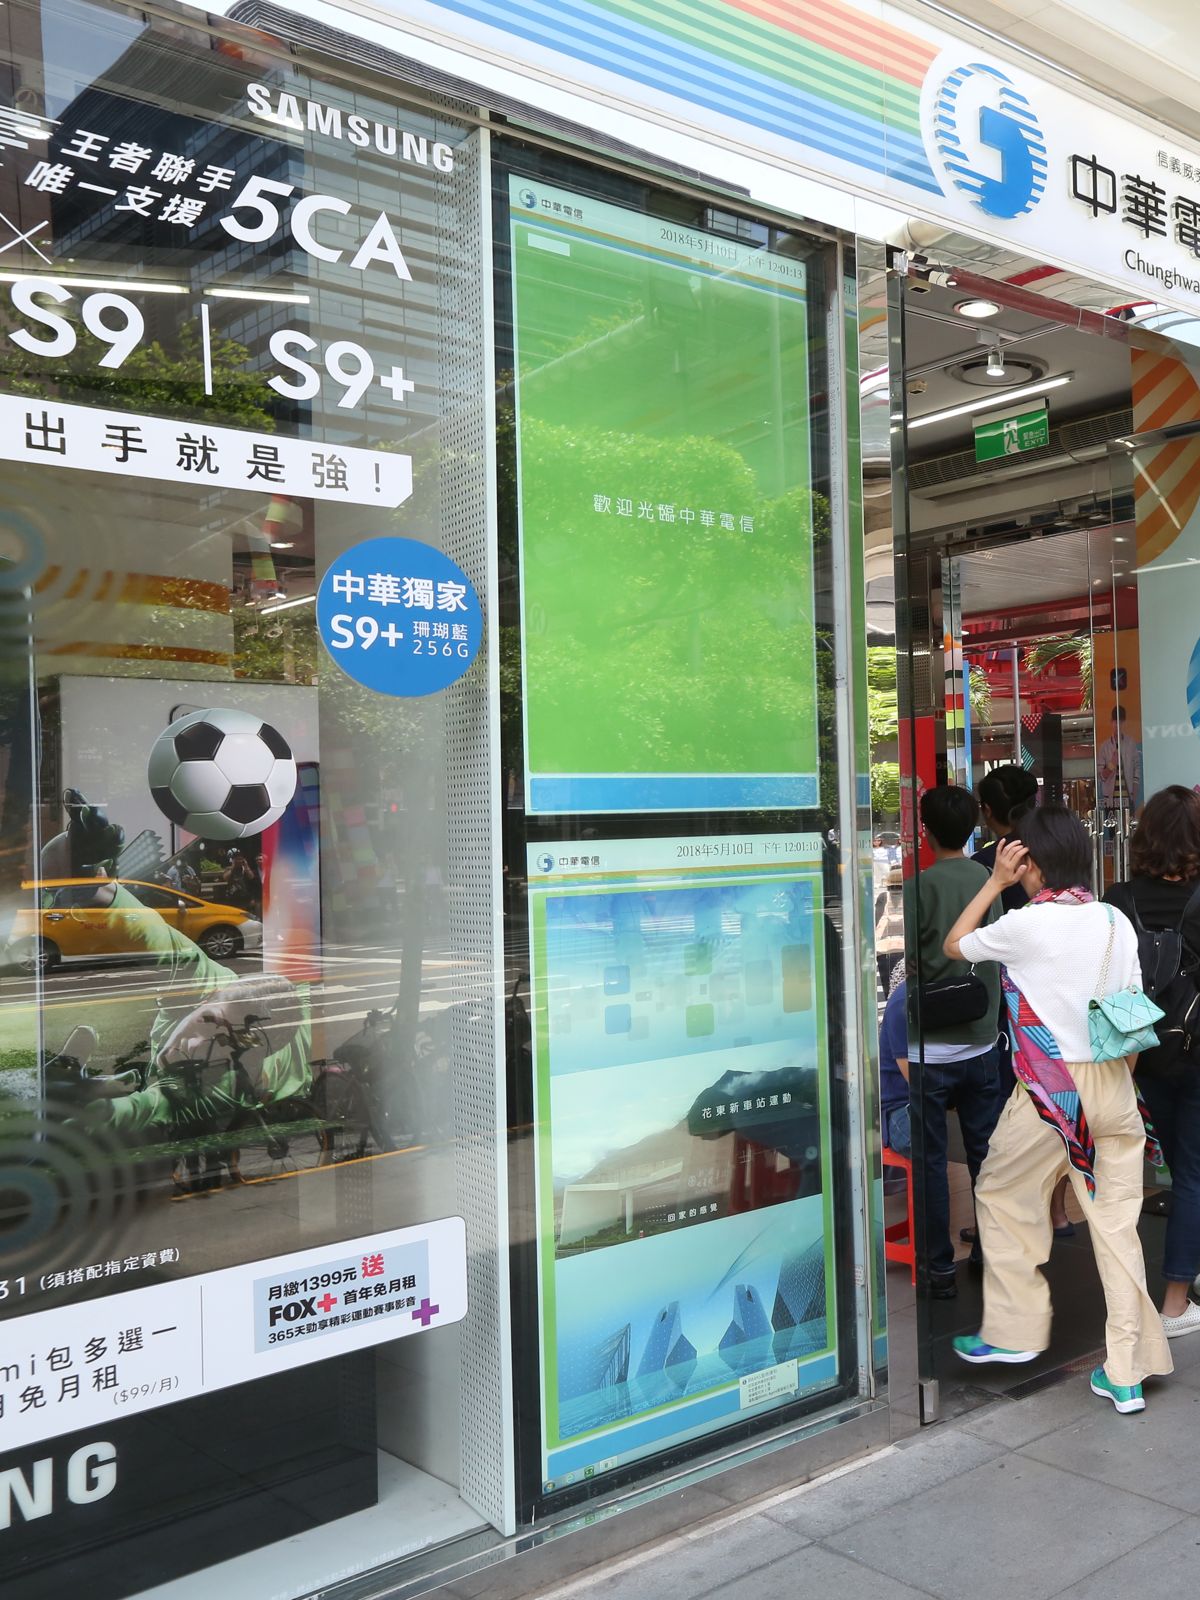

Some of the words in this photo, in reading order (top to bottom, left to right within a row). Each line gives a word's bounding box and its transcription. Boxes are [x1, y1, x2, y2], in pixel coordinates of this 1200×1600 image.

[246, 83, 454, 173] SAMSUNG
[60, 129, 236, 193] 王者聯手
[24, 161, 206, 228] 唯一支援
[541, 199, 583, 220] 中華電信
[219, 176, 413, 282] 5CA
[1124, 248, 1200, 295] Chunghwa
[8, 278, 145, 369] S9
[267, 329, 415, 409] S9+
[1025, 437, 1045, 446] EXIT
[593, 493, 755, 534] 歡迎光臨中華電信
[332, 570, 468, 612] 中華獨家
[331, 614, 403, 650] S9+
[413, 621, 468, 640] 珊瑚藍
[413, 640, 468, 658] 256G
[558, 855, 600, 867] 中華電信
[676, 842, 753, 858] 2018年5月10日
[784, 840, 819, 853] 12:01:10
[702, 1092, 792, 1119] 花東新車站運動
[667, 1203, 718, 1223] 回家的感覺
[40, 1248, 180, 1290] (須搭配指定資費)
[268, 1267, 357, 1300] 月繳1399元
[362, 1254, 385, 1279] 送
[344, 1275, 416, 1305] 首年免月租
[268, 1296, 416, 1344] 365天勁享精彩運動賽事影音
[114, 1376, 179, 1405] ($99/月)
